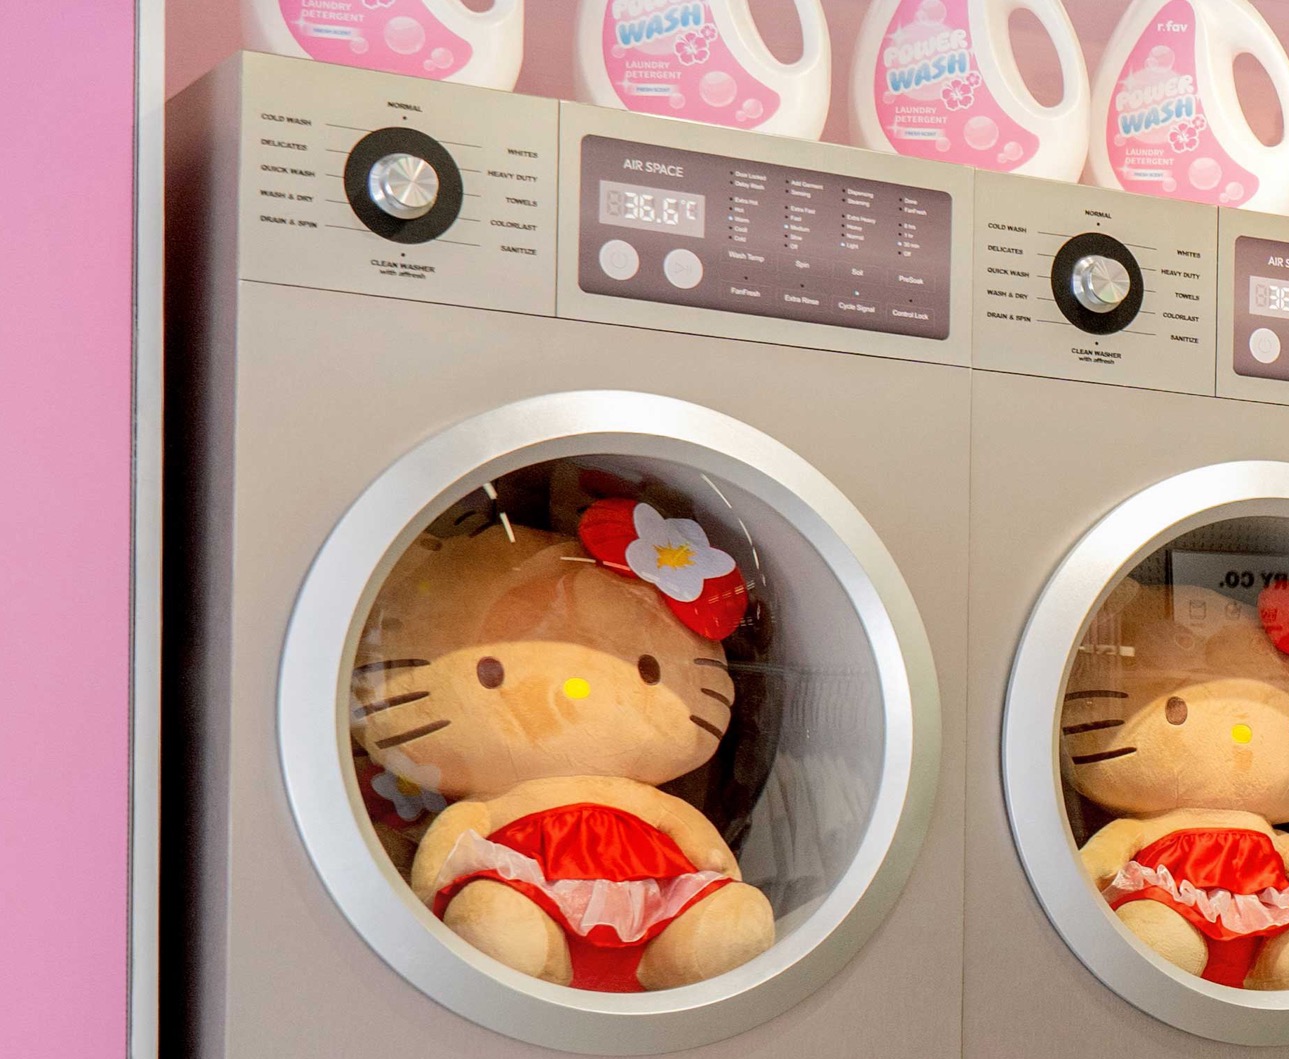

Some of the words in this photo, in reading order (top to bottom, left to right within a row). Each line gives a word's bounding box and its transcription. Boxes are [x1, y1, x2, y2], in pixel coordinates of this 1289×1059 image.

[302, 9, 364, 22] DETERGENT
[617, 2, 704, 46] WASH
[1157, 20, 1188, 33] r.fav
[883, 29, 968, 68] POWER
[625, 61, 670, 69] LAUNDRY
[625, 70, 682, 79] DETERGENT
[888, 51, 968, 92] WASH
[1115, 75, 1195, 112] POWER
[387, 100, 422, 112] NORMAL
[895, 106, 937, 114] LAUNDRY
[261, 112, 285, 123] COLD
[286, 116, 312, 126] WASH
[895, 115, 948, 124] DETERGENT
[1121, 96, 1194, 135] WASH
[260, 138, 307, 151] DELICATES
[507, 148, 538, 158] WHITES
[1125, 148, 1164, 156] LAUNDRY
[622, 157, 643, 171] AIR
[645, 161, 684, 178] SPACE
[1125, 158, 1174, 166] DETERGENT
[260, 163, 288, 174] QUICK
[289, 167, 315, 177] WASH
[486, 169, 513, 179] HEAVY
[515, 173, 537, 183] DUTY
[259, 189, 285, 199] WASH
[296, 194, 313, 202] DRY
[505, 196, 537, 207] TOWELS
[1084, 209, 1111, 219] NORMAL
[259, 214, 286, 224] DRAIN
[297, 219, 317, 228] SPIN
[987, 222, 1006, 230] COLD
[1006, 224, 1027, 233] WASH
[500, 245, 537, 256] SANITIZE
[987, 244, 1023, 255] DELICATES
[1176, 249, 1201, 258] WHITES
[370, 258, 398, 269] CLEAN
[399, 262, 436, 273] WASHER
[1267, 255, 1283, 267] AIR
[987, 266, 1009, 275] QUICK
[1009, 269, 1030, 278] WASH
[1160, 268, 1182, 277] HEAVY
[987, 289, 1007, 297] WASH
[1015, 292, 1028, 300] DRY
[1174, 292, 1200, 301] TOWELS
[987, 311, 1007, 319] DRAIN
[1016, 314, 1031, 322] SPIN
[1170, 334, 1198, 343] SANITIZE
[1071, 347, 1093, 356] CLEAN
[1093, 350, 1121, 359] WASHER
